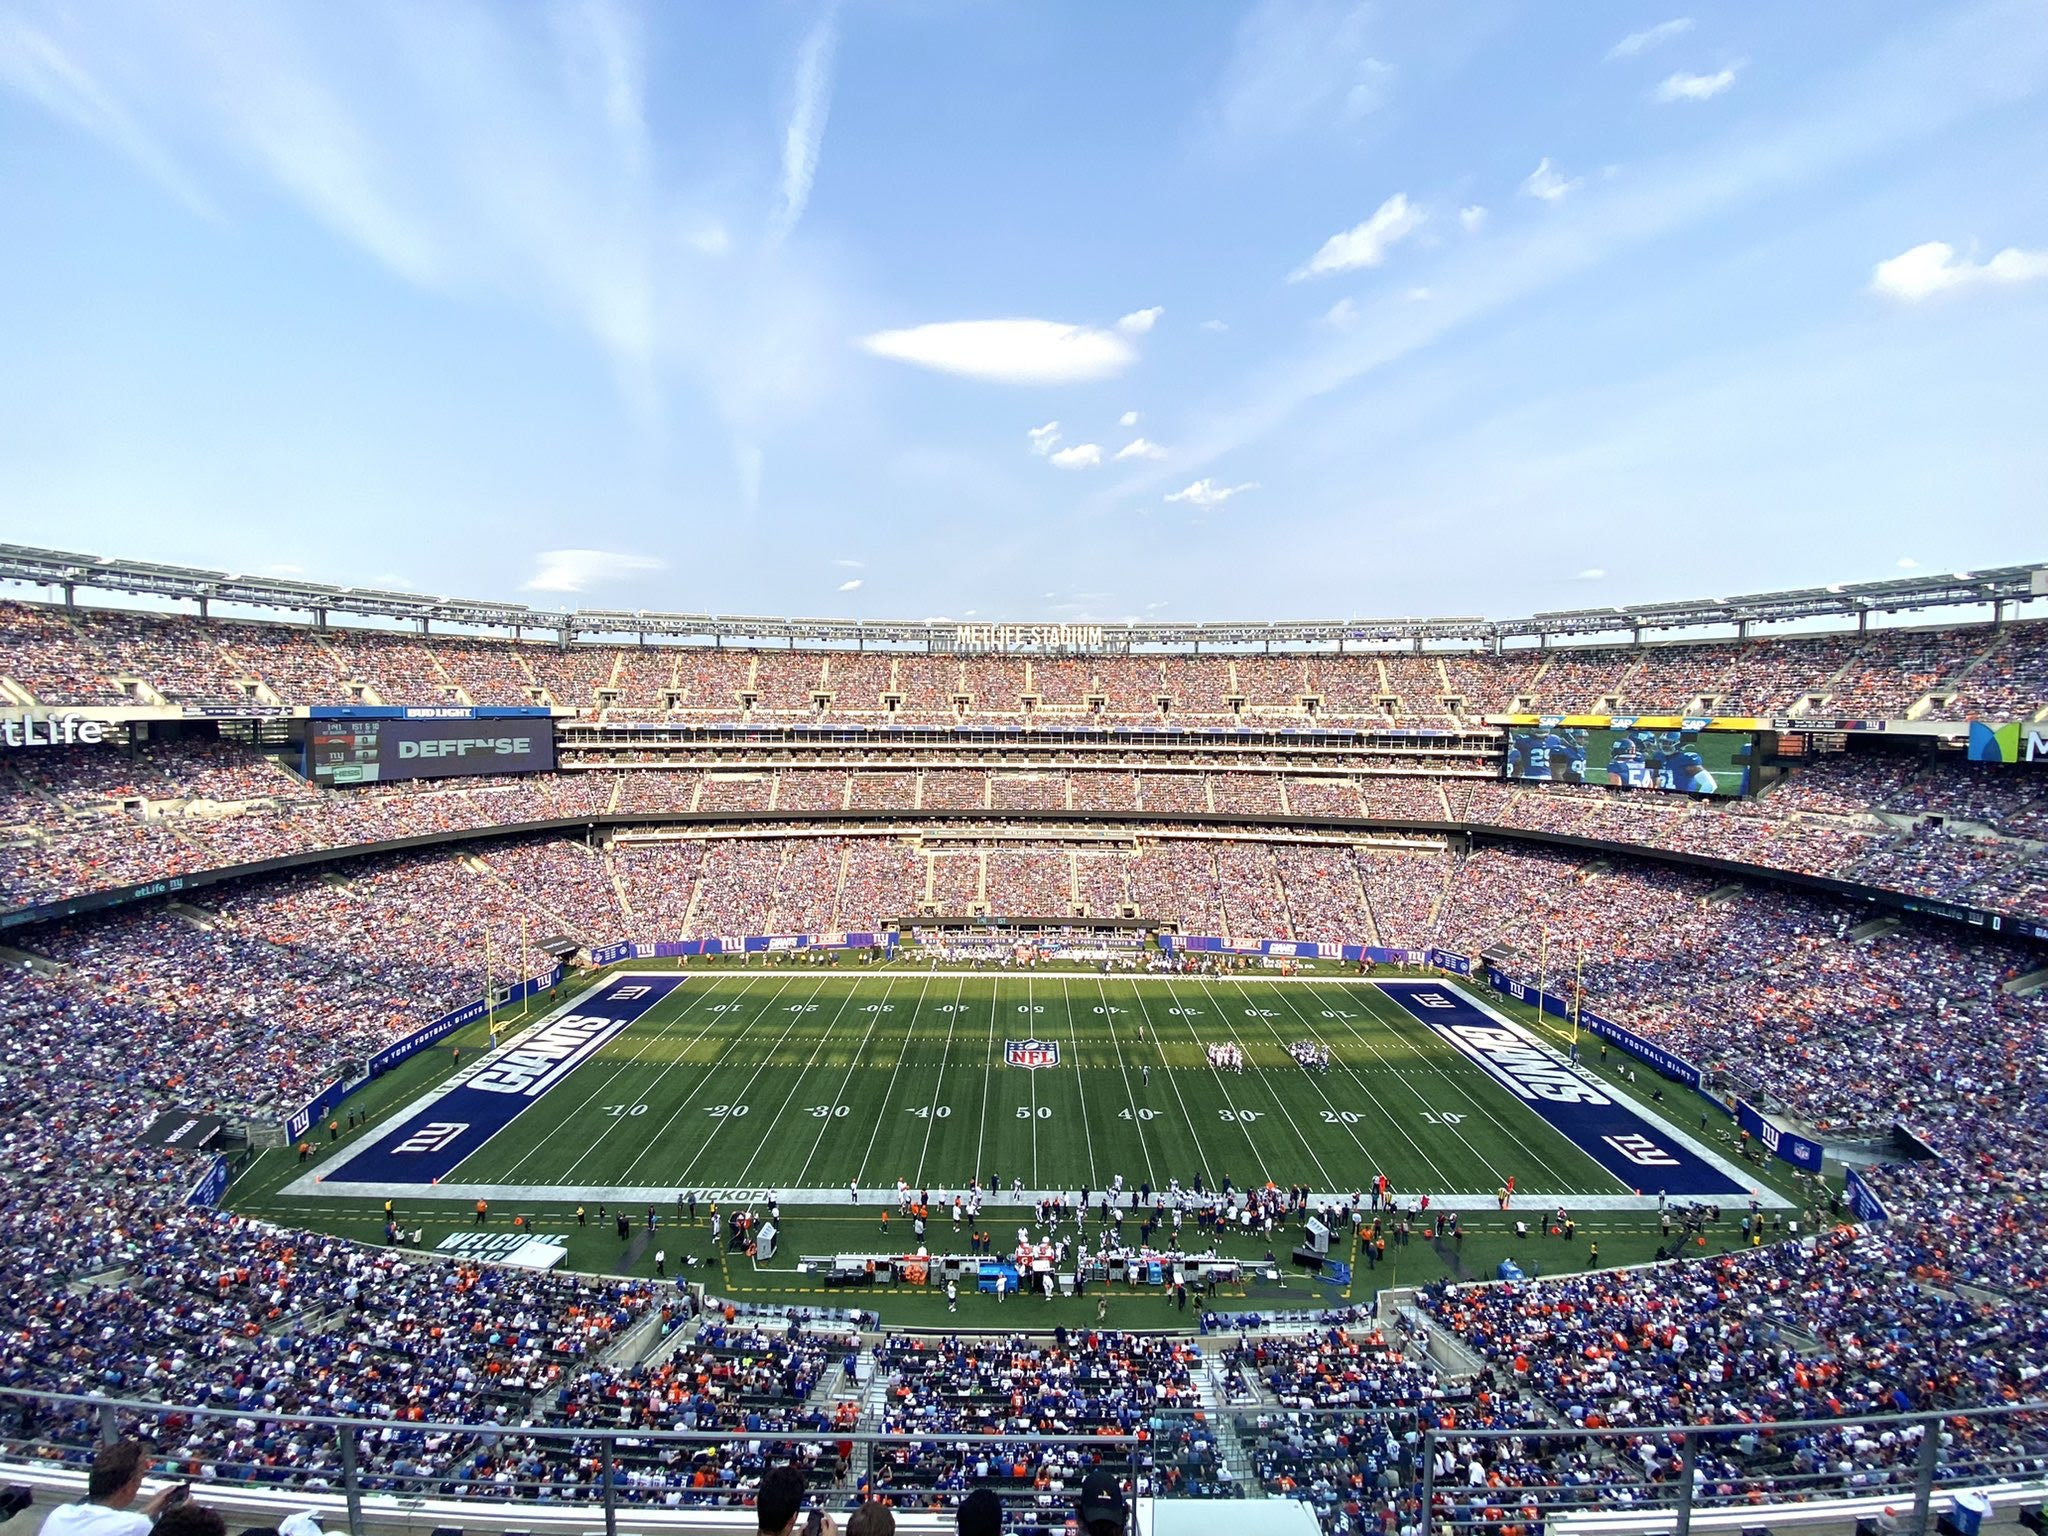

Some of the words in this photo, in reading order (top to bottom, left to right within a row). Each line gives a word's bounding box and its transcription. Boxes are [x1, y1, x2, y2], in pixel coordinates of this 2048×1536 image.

[957, 625, 1025, 645] METLIFE
[1031, 626, 1102, 645] STADIUM
[407, 708, 433, 718] BUD
[435, 708, 472, 718] LIGHT
[1539, 717, 1560, 728] SAP
[1610, 718, 1632, 729] SAP
[1682, 718, 1703, 730] SAP
[637, 943, 656, 958] ny
[721, 936, 745, 953] ny
[1317, 943, 1342, 960] ny
[1406, 950, 1425, 964] ny
[536, 972, 552, 991] ny
[606, 985, 653, 1001] ny
[1509, 981, 1525, 1000] ny
[1410, 992, 1457, 1008] ny
[390, 1042, 412, 1059] YORK
[414, 1021, 452, 1047] FOOTBALL
[455, 1006, 483, 1023] GIANTS
[1581, 1015, 1598, 1029] NW
[1601, 1025, 1621, 1041] YORK
[1624, 1037, 1664, 1064] FOOTBALL
[466, 1014, 612, 1094] GIANTS
[1011, 1050, 1054, 1065] NFL
[1450, 1025, 1612, 1106] GIANTS
[607, 1104, 648, 1117] 10
[709, 1104, 750, 1117] 20
[811, 1104, 850, 1118] 30
[914, 1105, 952, 1119] 40
[1015, 1106, 1052, 1120] 50
[1117, 1107, 1155, 1121] 40
[1218, 1108, 1256, 1122] 30
[1319, 1110, 1359, 1123] 20
[1419, 1111, 1460, 1124] 10
[164, 1119, 200, 1143] verizon
[291, 1108, 310, 1138] ny
[390, 1121, 470, 1155] ny
[1761, 1121, 1779, 1152] ny
[1601, 1132, 1681, 1166] ny
[435, 1232, 570, 1250] WELCOME
